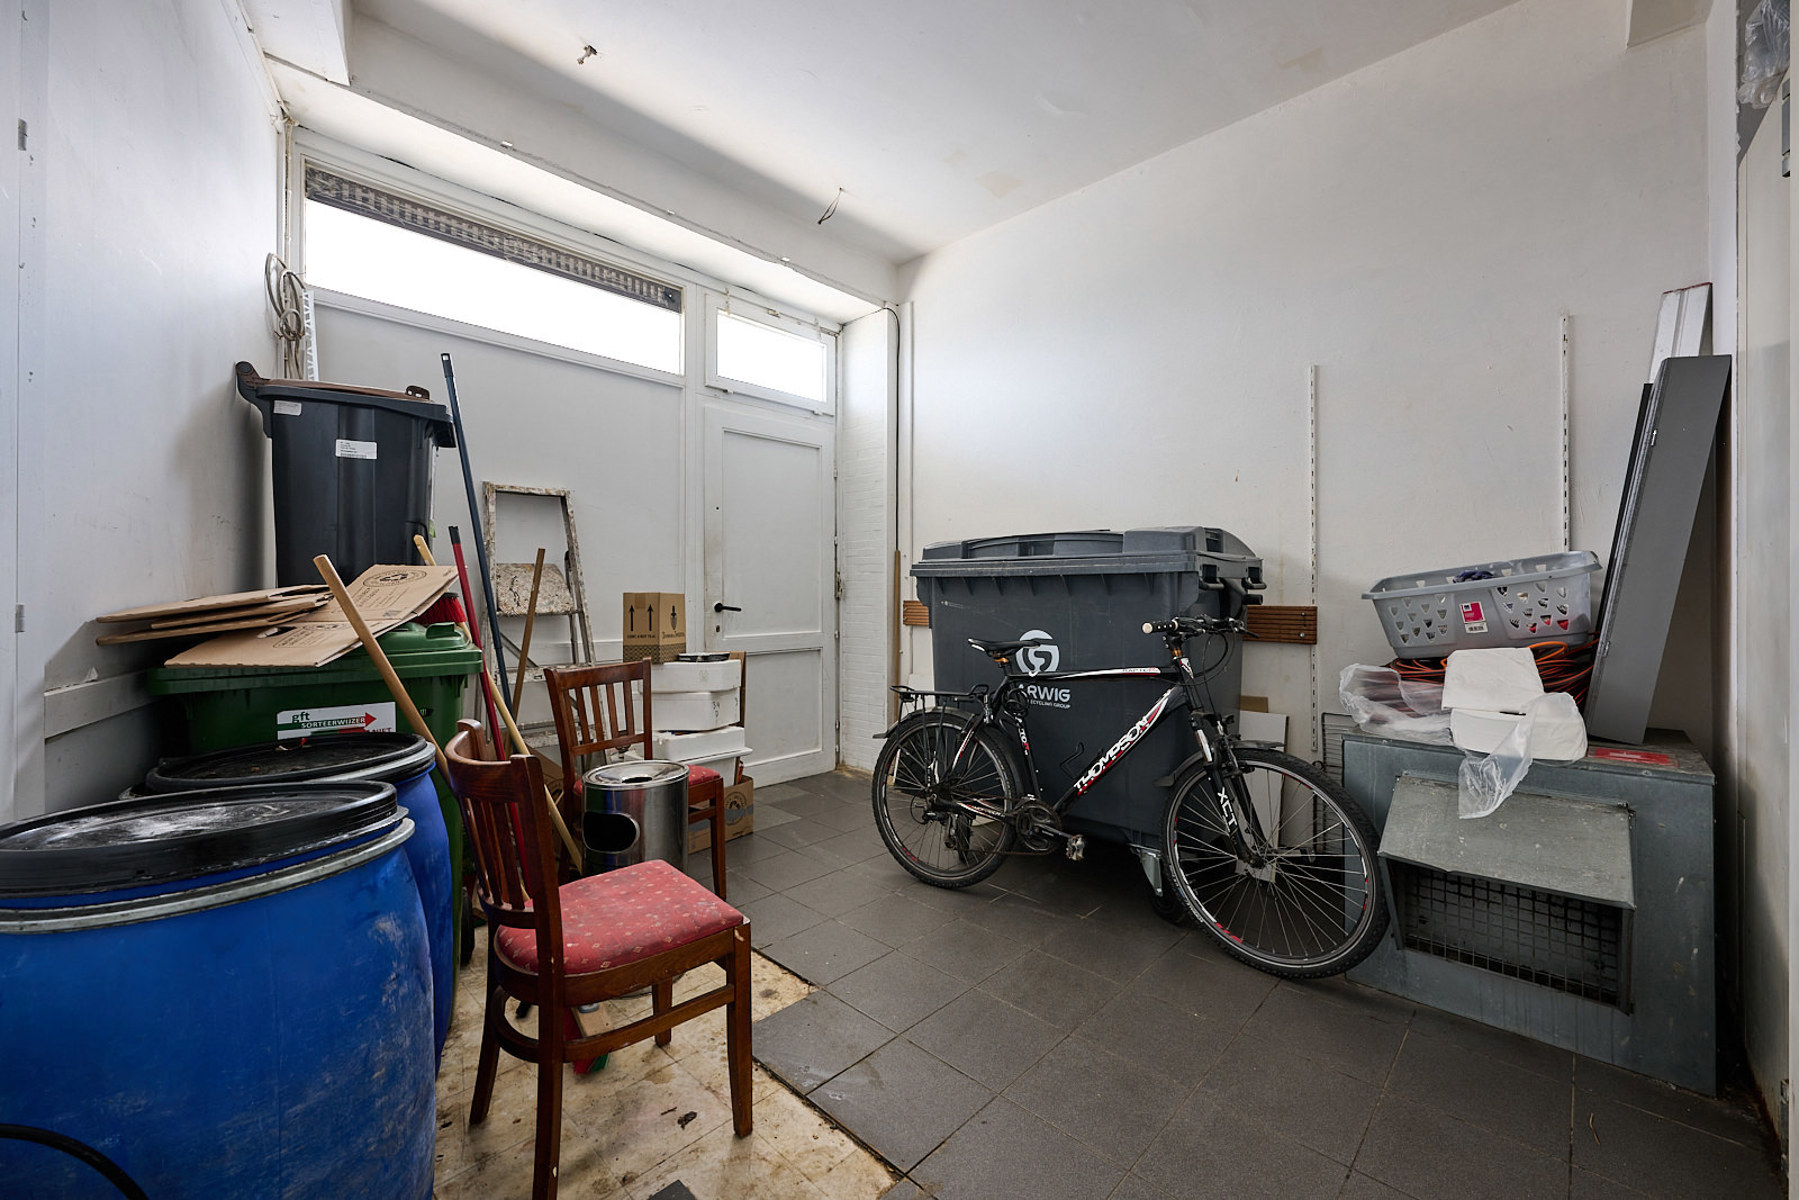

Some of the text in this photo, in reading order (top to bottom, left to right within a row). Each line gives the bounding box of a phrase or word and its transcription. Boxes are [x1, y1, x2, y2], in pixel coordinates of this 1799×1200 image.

[291, 711, 310, 723] gft
[1073, 715, 1150, 792] THOMPSON
[1217, 786, 1238, 826] XCT
